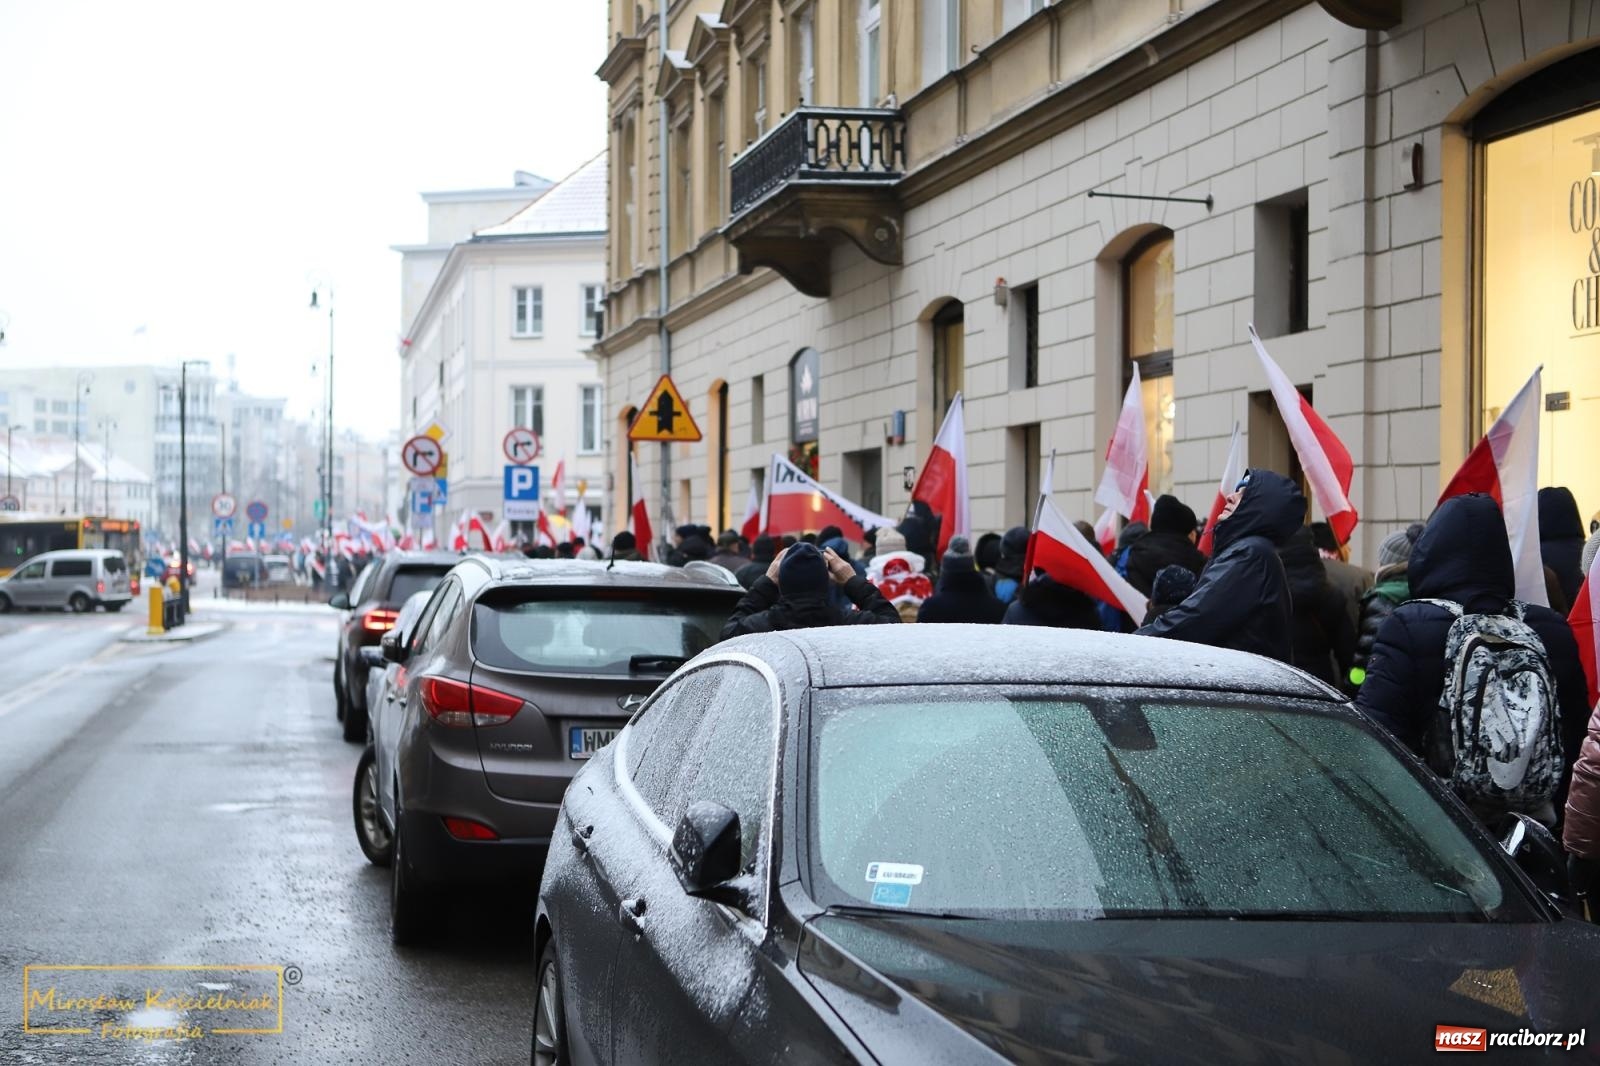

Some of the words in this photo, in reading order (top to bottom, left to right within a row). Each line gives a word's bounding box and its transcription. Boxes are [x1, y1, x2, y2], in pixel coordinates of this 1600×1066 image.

[1569, 177, 1600, 234] CO
[511, 468, 533, 498] P
[489, 742, 533, 752] HYUNDAI
